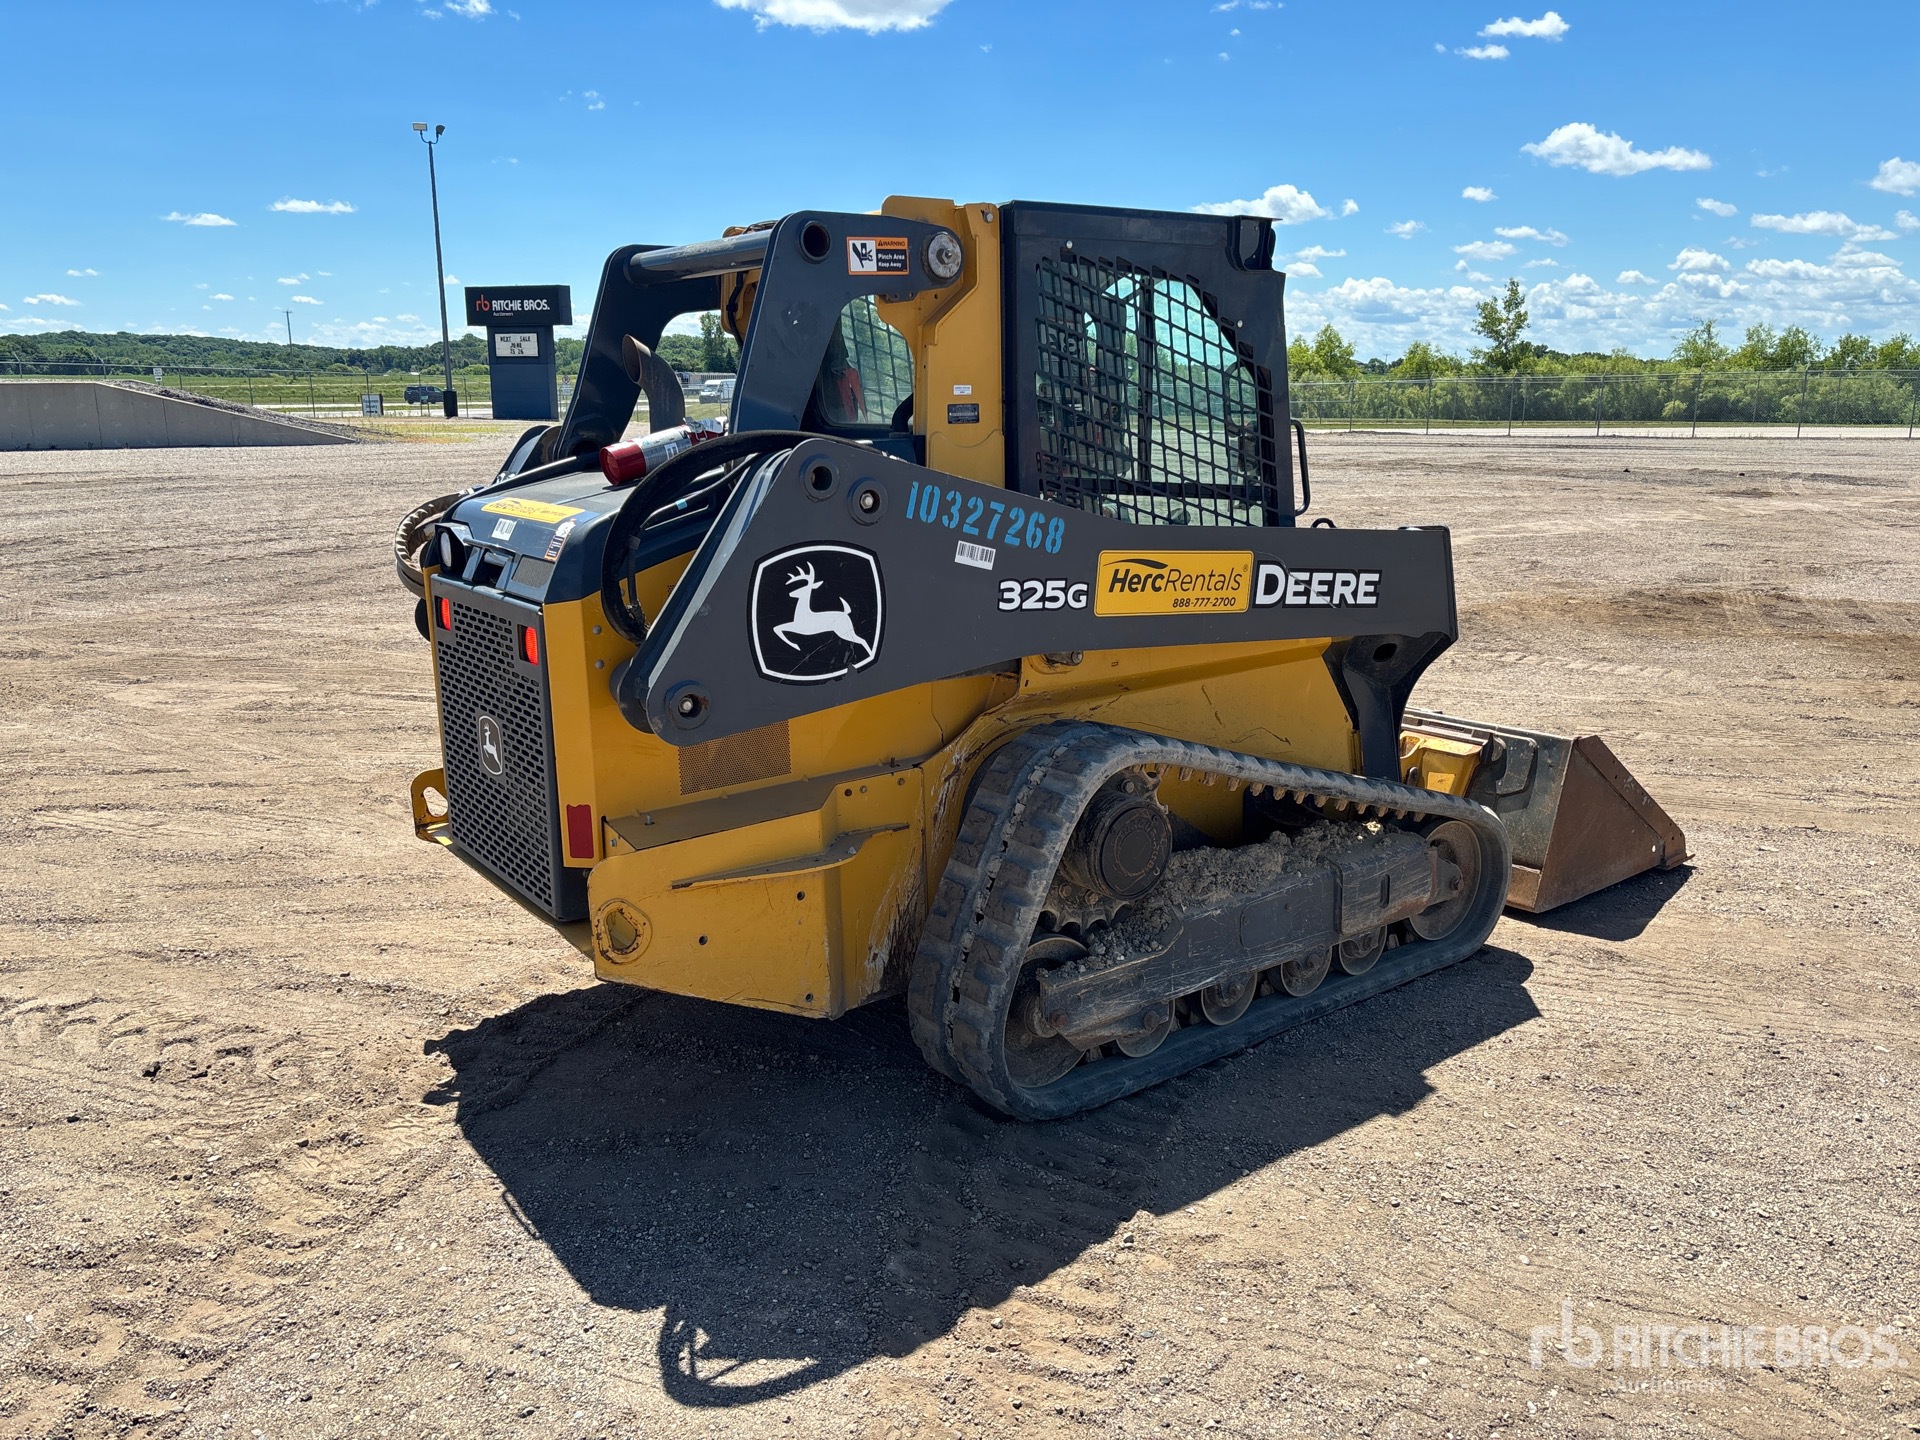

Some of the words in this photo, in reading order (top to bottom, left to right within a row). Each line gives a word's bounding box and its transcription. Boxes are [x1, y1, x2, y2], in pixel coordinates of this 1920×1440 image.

[492, 299, 522, 311] RITCHIE
[523, 299, 550, 311] BROS.
[905, 480, 1066, 555] 10327268
[998, 579, 1089, 611] 325G
[1255, 564, 1380, 605] DEERE
[1172, 596, 1236, 608] 888-777-2700
